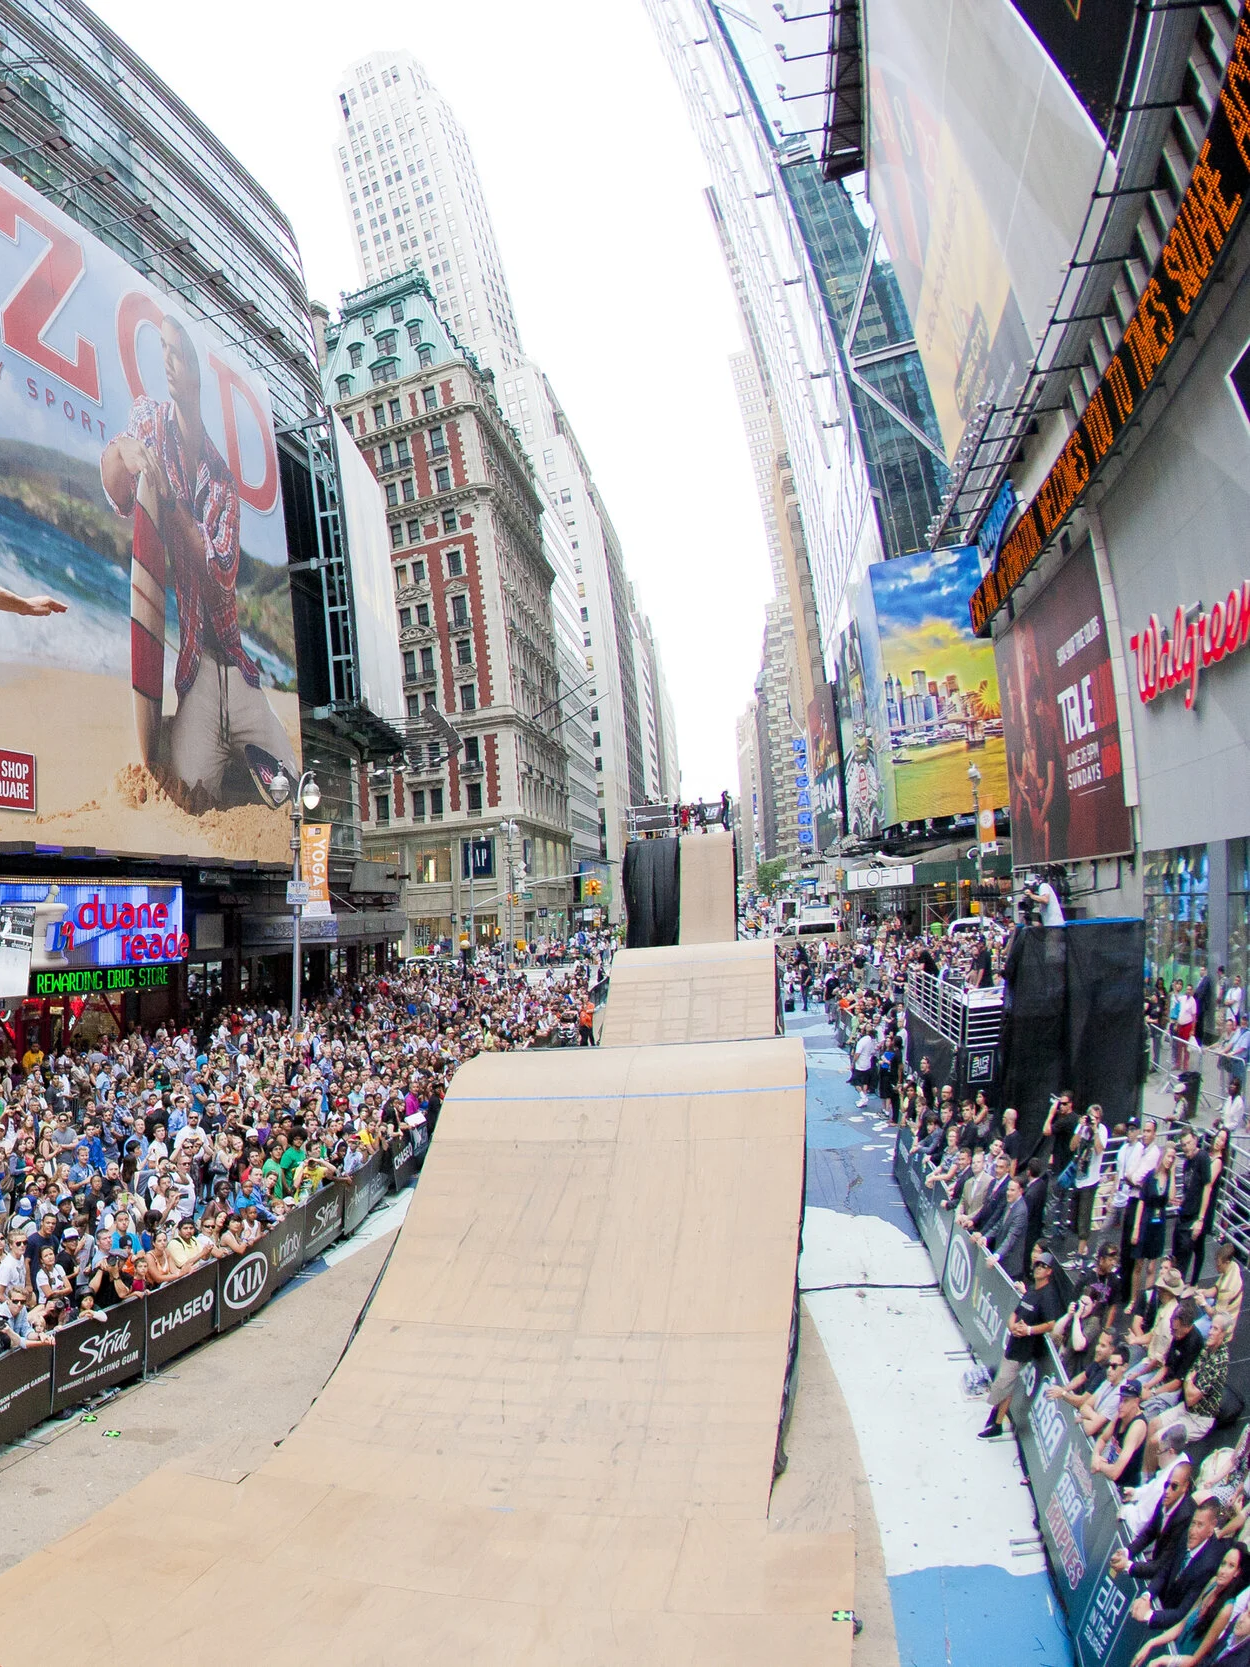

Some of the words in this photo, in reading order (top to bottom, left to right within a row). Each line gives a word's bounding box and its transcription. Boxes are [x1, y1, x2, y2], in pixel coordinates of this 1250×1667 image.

[25, 376, 109, 442] SPORT
[1035, 430, 1091, 537] WELCOMES
[1083, 387, 1114, 465] YOU
[1105, 355, 1135, 425] TO
[1123, 277, 1176, 391] TIMES
[1057, 673, 1096, 745] TRUE
[1, 760, 30, 780] SHOP
[1067, 762, 1102, 791] SUNDAYS
[792, 738, 813, 844] NYGARD
[312, 838, 327, 887] YOGA
[856, 867, 904, 888] LOFT
[78, 893, 169, 931] duane
[414, 925, 431, 936] THE
[121, 924, 191, 962] reade
[36, 970, 103, 995] REWARDING
[107, 968, 135, 990] DRUG
[139, 966, 169, 986] STORE
[233, 1261, 263, 1301] KIA
[950, 1246, 967, 1292] KIA
[69, 1320, 132, 1376] Stride
[84, 1372, 97, 1383] LONG
[97, 1361, 120, 1379] LASTING
[121, 1350, 139, 1366] GUM
[10, 1381, 31, 1400] SQUARE
[30, 1371, 50, 1388] GARDEN
[1046, 1494, 1086, 1591] TRIPLES
